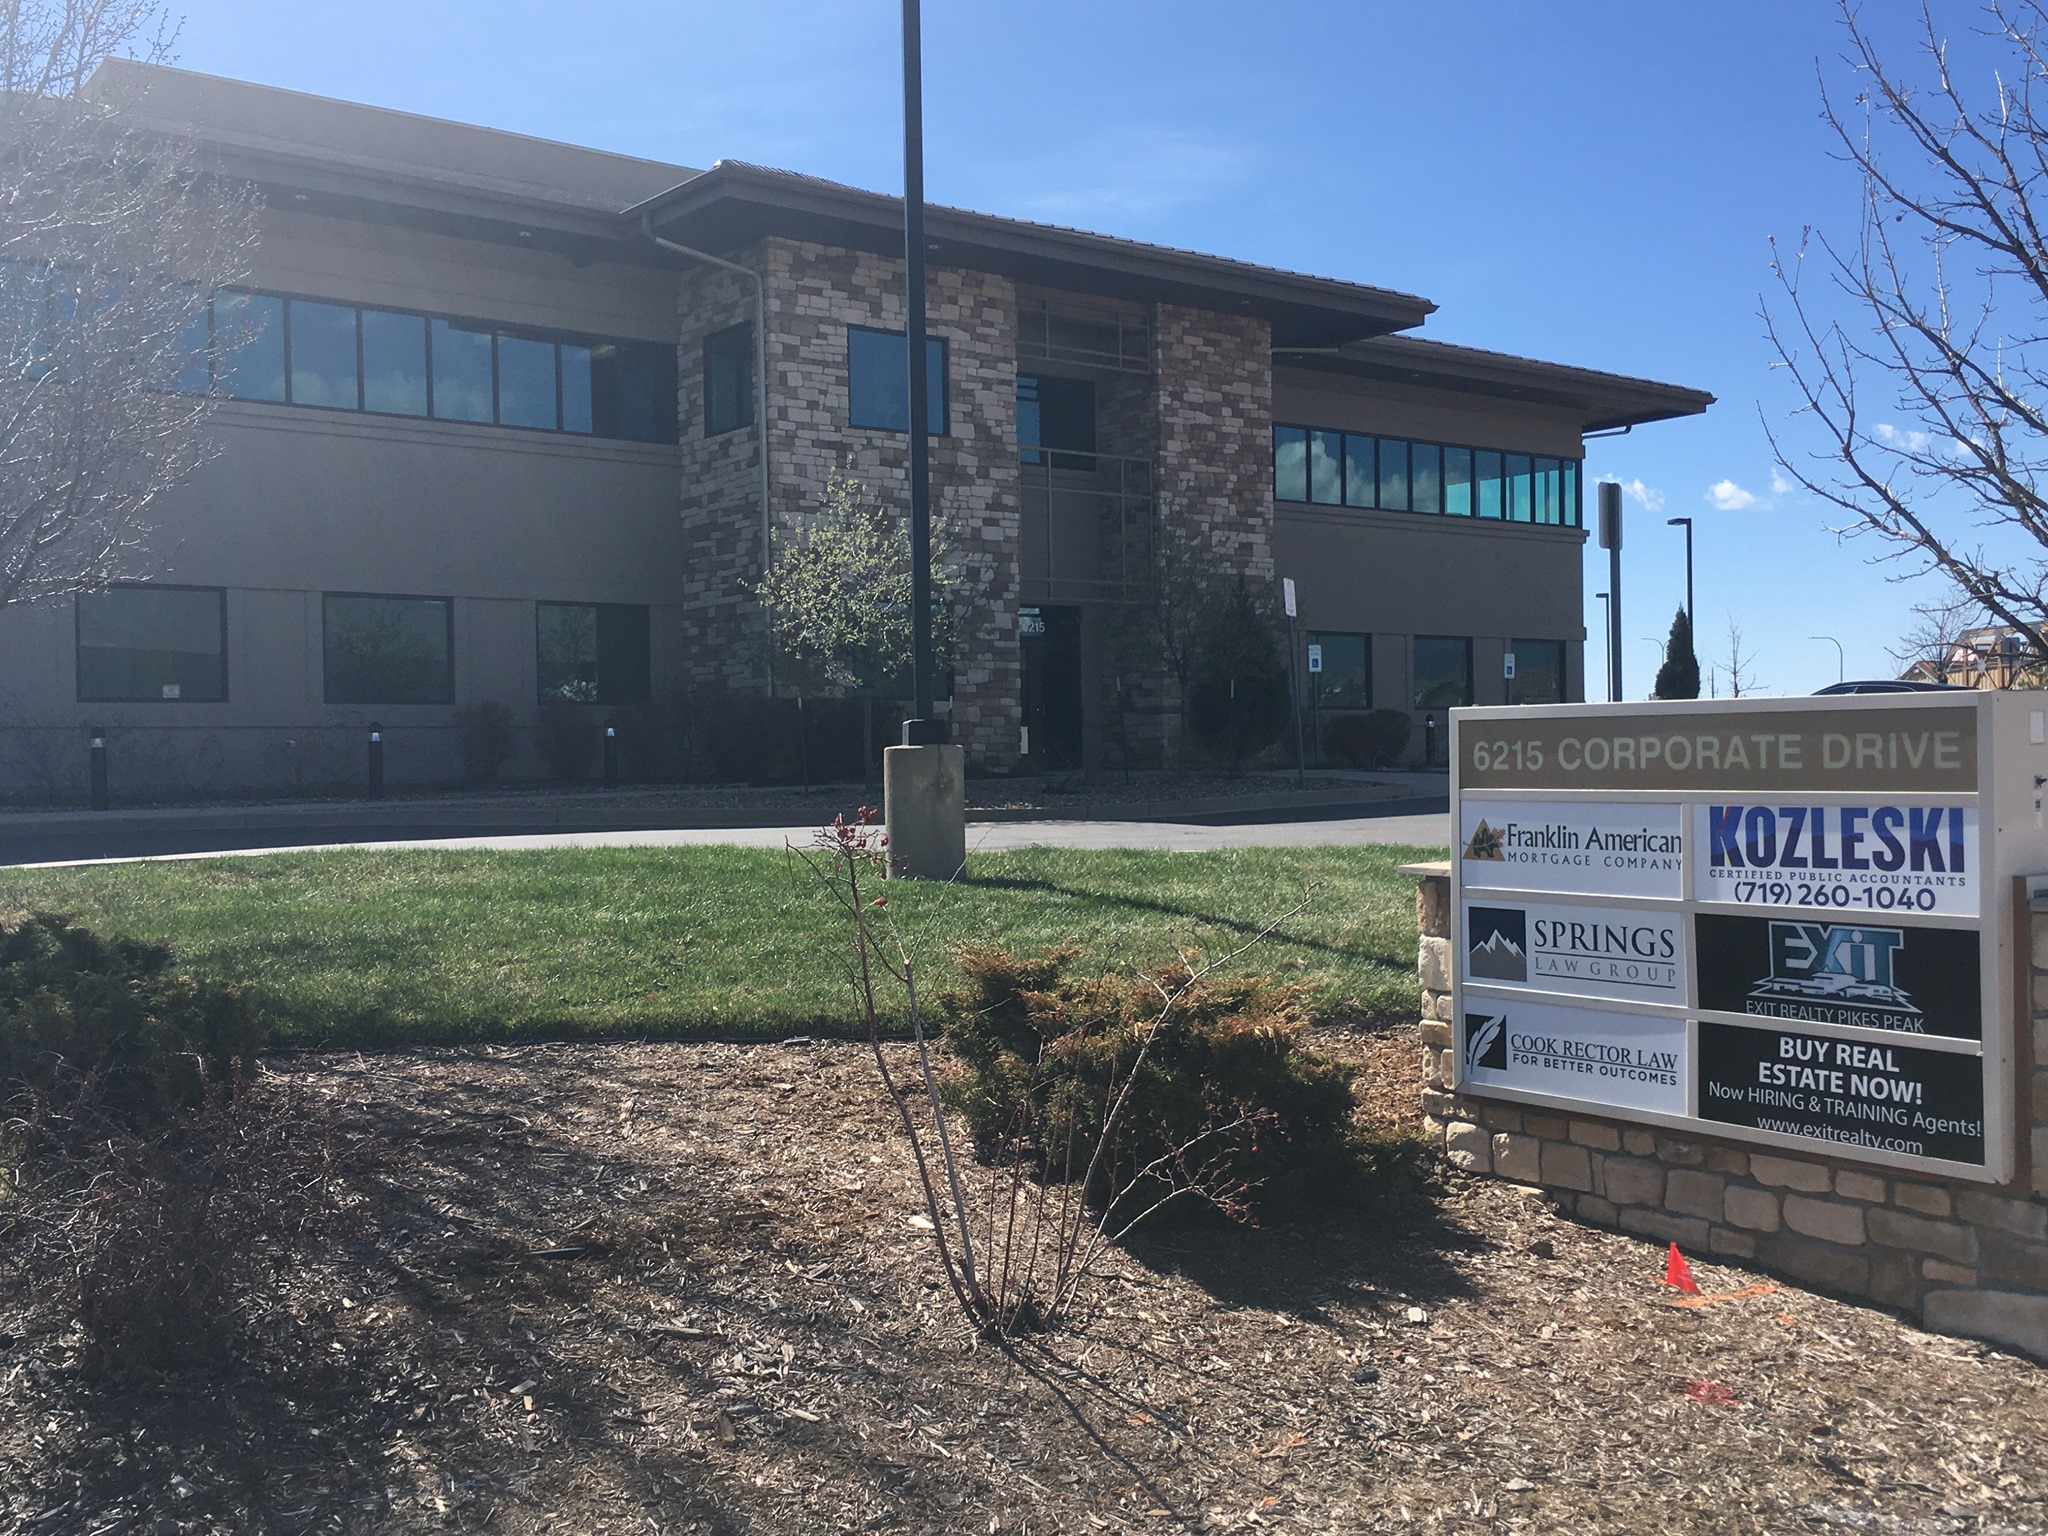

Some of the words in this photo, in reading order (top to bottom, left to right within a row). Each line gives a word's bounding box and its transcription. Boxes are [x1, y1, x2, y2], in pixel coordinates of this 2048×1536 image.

[1473, 740, 1544, 771] 6215
[1557, 735, 1803, 771] CORPORATE
[1822, 731, 1962, 769] DRIVE
[1507, 823, 1579, 850] Franklin
[1584, 826, 1682, 854] American
[1709, 806, 1965, 873] KOZLESKI
[1507, 852, 1591, 867] MORTGAGE
[1603, 855, 1682, 871] COMPANY
[1709, 869, 1782, 880] CERTIFIED
[1790, 871, 1843, 882] PUBLIC
[1849, 873, 1966, 887] ACCOUNTANTS
[1734, 881, 1792, 905] (719)
[1798, 883, 1936, 911] 260-1040
[1534, 919, 1674, 958] SPRINGS
[1535, 956, 1579, 973] LAW
[1589, 963, 1676, 983] GROUP
[1746, 1000, 1777, 1017] EXIT
[1779, 1003, 1834, 1024] REALTY
[1838, 1011, 1879, 1029] PIKES
[1884, 1015, 1925, 1034] PEAK
[1511, 1033, 1558, 1055] COOK
[1563, 1042, 1631, 1065] RECTOR
[1637, 1052, 1678, 1070] LAW
[1780, 1037, 1831, 1062] BUY
[1835, 1046, 1899, 1072] REAL
[1512, 1053, 1538, 1066] FOR
[1543, 1058, 1594, 1074] BETTER
[1599, 1065, 1677, 1086] OUTCOMES
[1758, 1062, 1844, 1094] ESTATE
[1850, 1075, 1923, 1105] NOW!
[1708, 1081, 1744, 1100] Now
[1748, 1087, 1805, 1110] HIRING
[1808, 1097, 1821, 1113] &
[1824, 1098, 1908, 1125] TRAINING
[1912, 1111, 1982, 1137] Agents!
[1757, 1117, 1923, 1154] www.exitrealty.com
